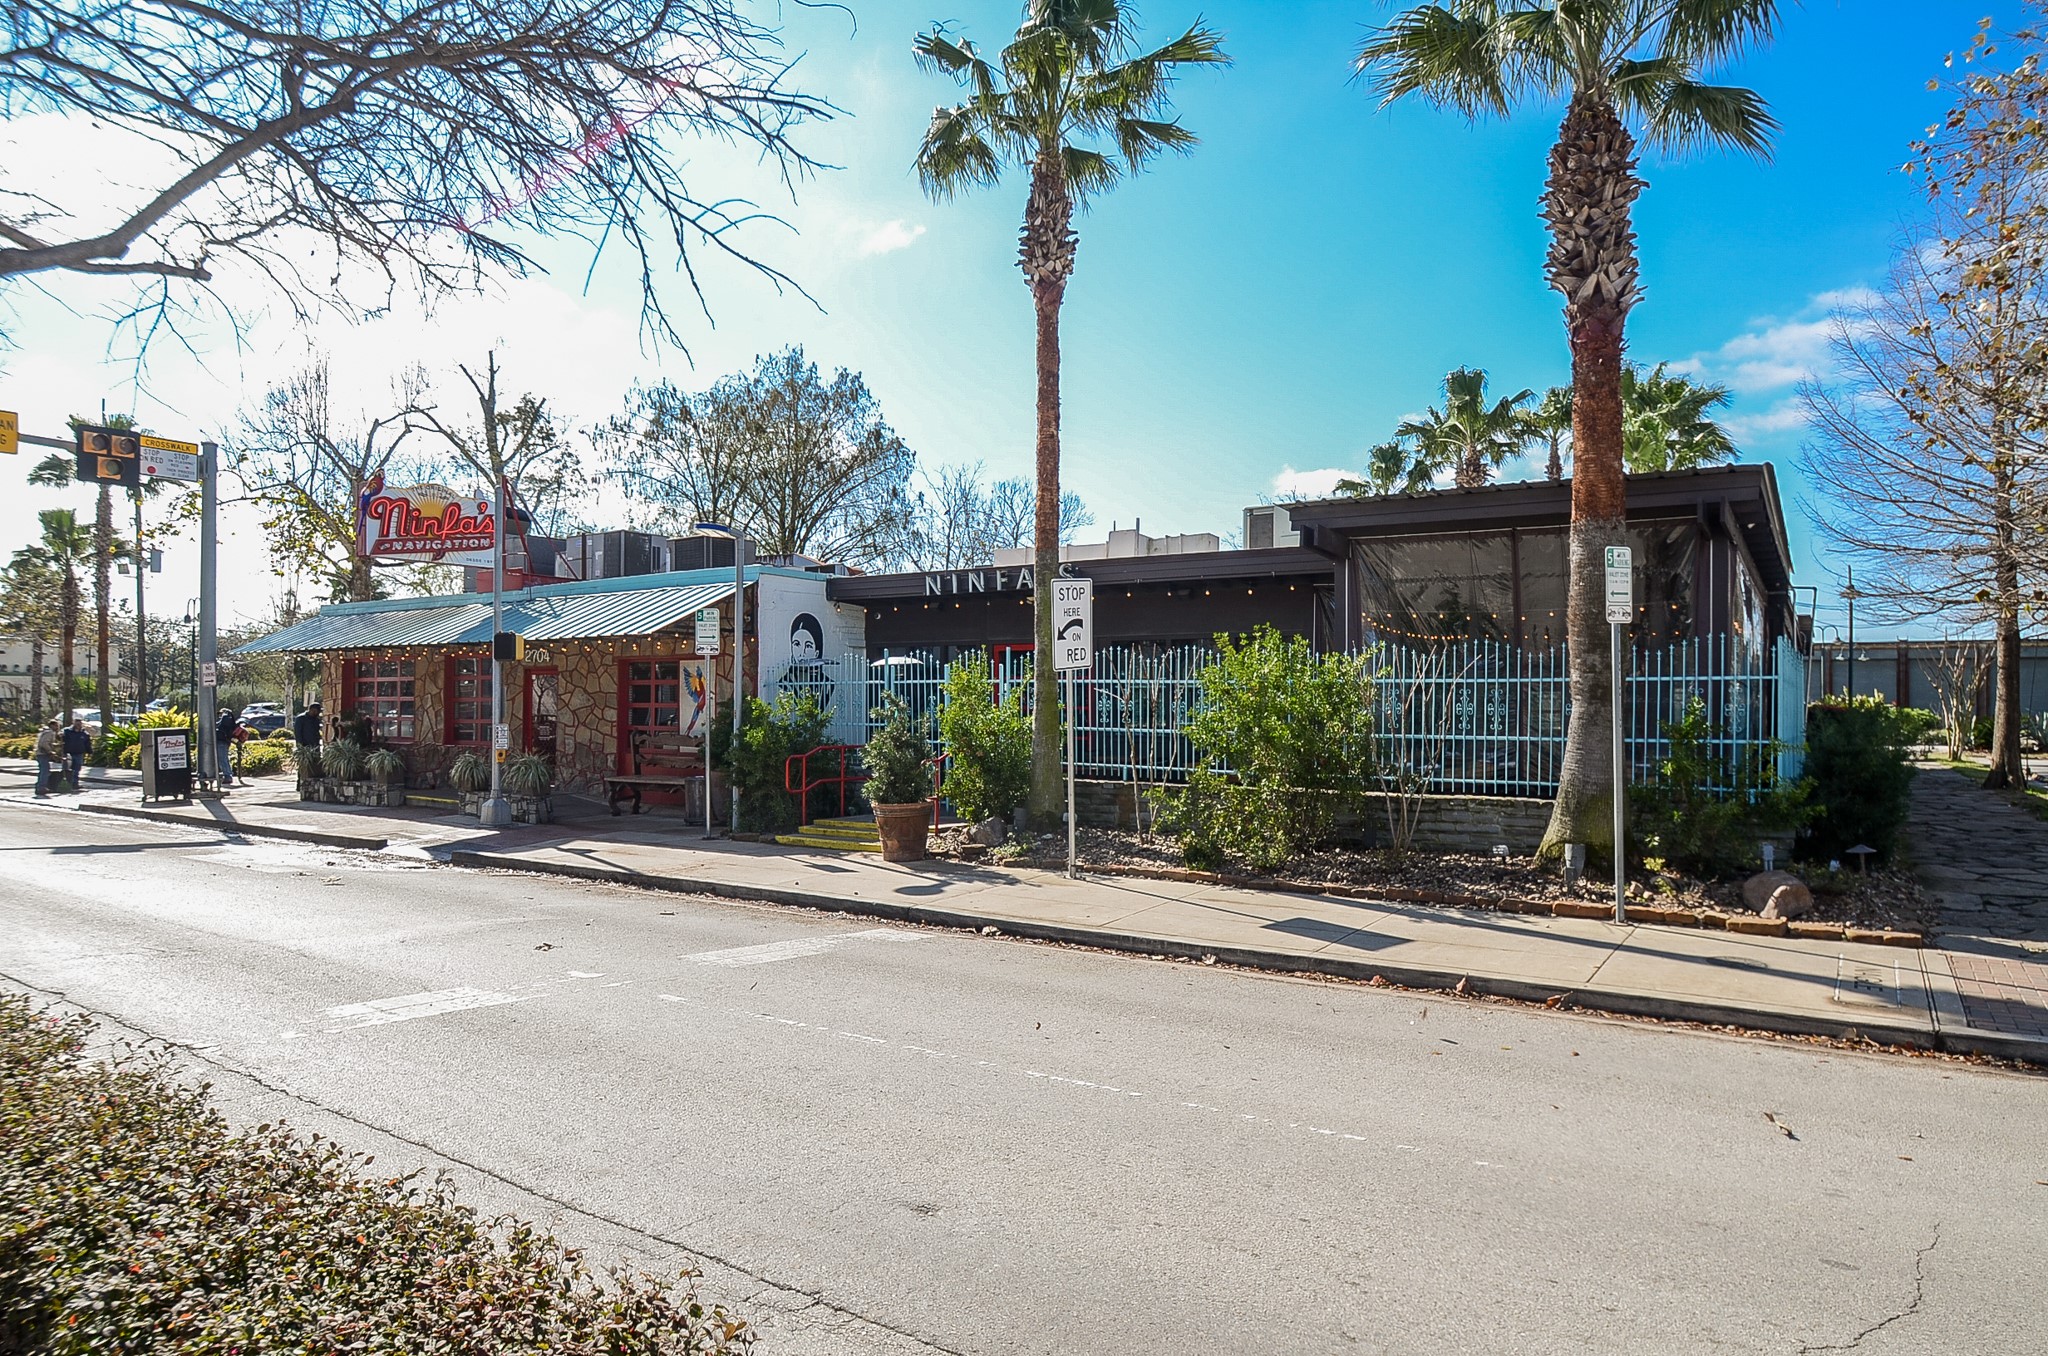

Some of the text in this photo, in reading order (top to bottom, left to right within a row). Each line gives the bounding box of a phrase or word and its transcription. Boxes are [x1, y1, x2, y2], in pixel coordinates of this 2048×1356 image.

[145, 439, 191, 452] CROSSWALK
[150, 456, 164, 464] RED
[174, 453, 190, 461] STOP
[367, 496, 495, 562] Ninfa's
[392, 539, 490, 551] NAVIGATION
[1607, 552, 1613, 564] 5
[925, 563, 1073, 596] NINFAS
[1058, 585, 1086, 602] STOP
[697, 611, 703, 620] 5
[1063, 607, 1081, 617] HERE
[1072, 632, 1081, 642] ON
[525, 650, 550, 662] 2704
[1067, 648, 1087, 664] RED
